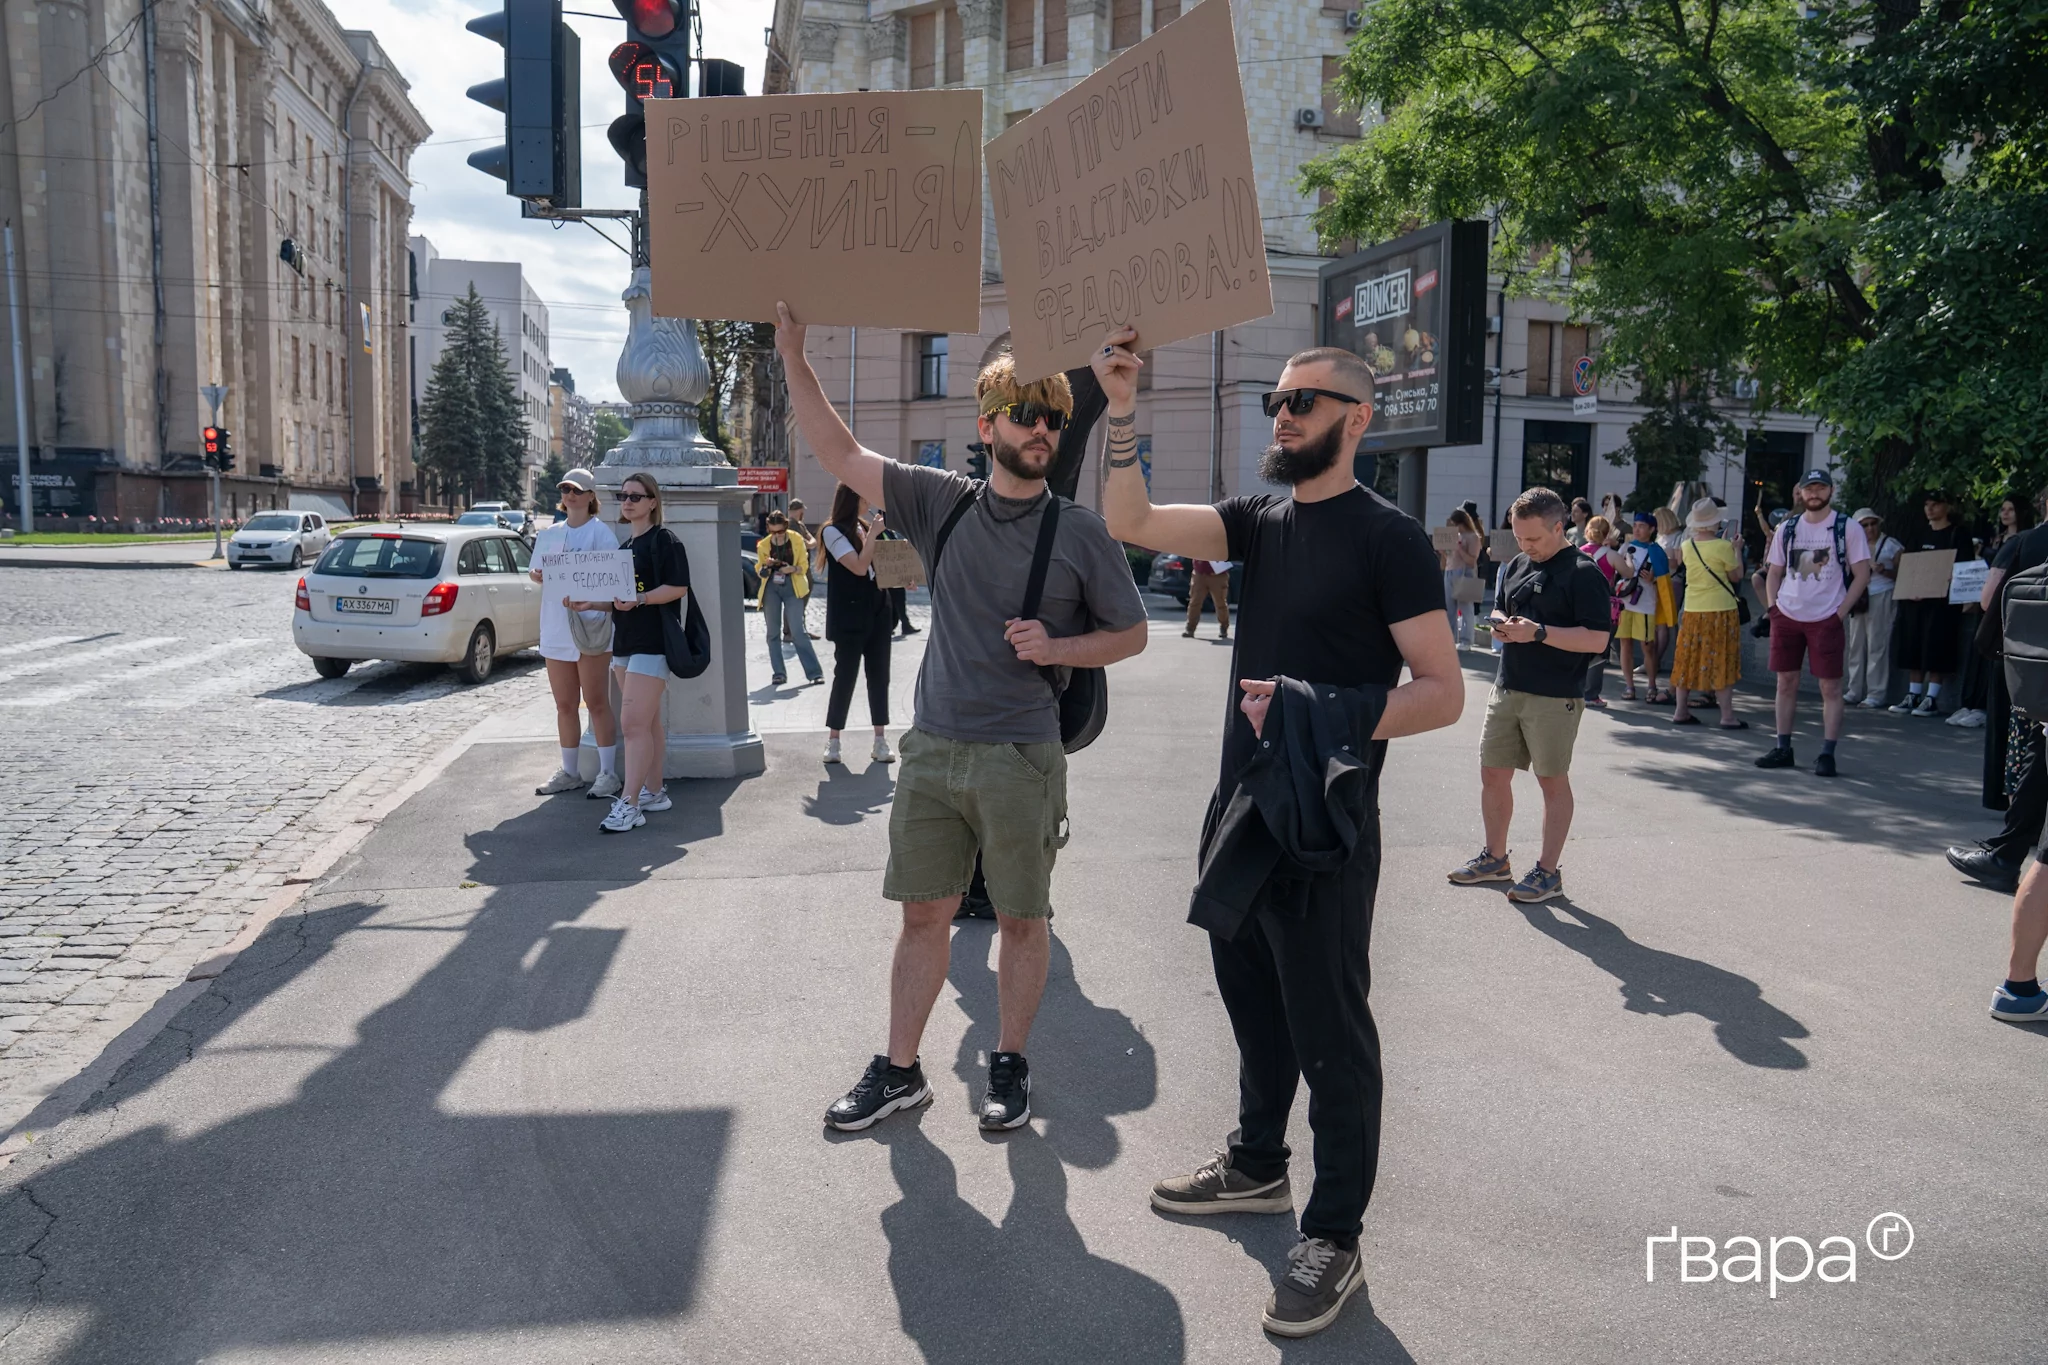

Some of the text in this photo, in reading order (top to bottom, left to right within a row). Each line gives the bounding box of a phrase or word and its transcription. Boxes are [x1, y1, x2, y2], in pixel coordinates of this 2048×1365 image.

[997, 50, 1173, 219] МИ ПРОТИ
[1357, 272, 1409, 324] BUNKER
[1395, 388, 1428, 402] Сумська,
[1430, 383, 1438, 394] 78
[1384, 404, 1398, 416] 096
[1399, 401, 1414, 415] 335
[1415, 399, 1425, 412] 47
[1427, 398, 1437, 411] 70
[206, 442, 218, 452] 53
[342, 600, 356, 608] AX
[356, 600, 376, 610] 3367
[377, 602, 390, 611] MA
